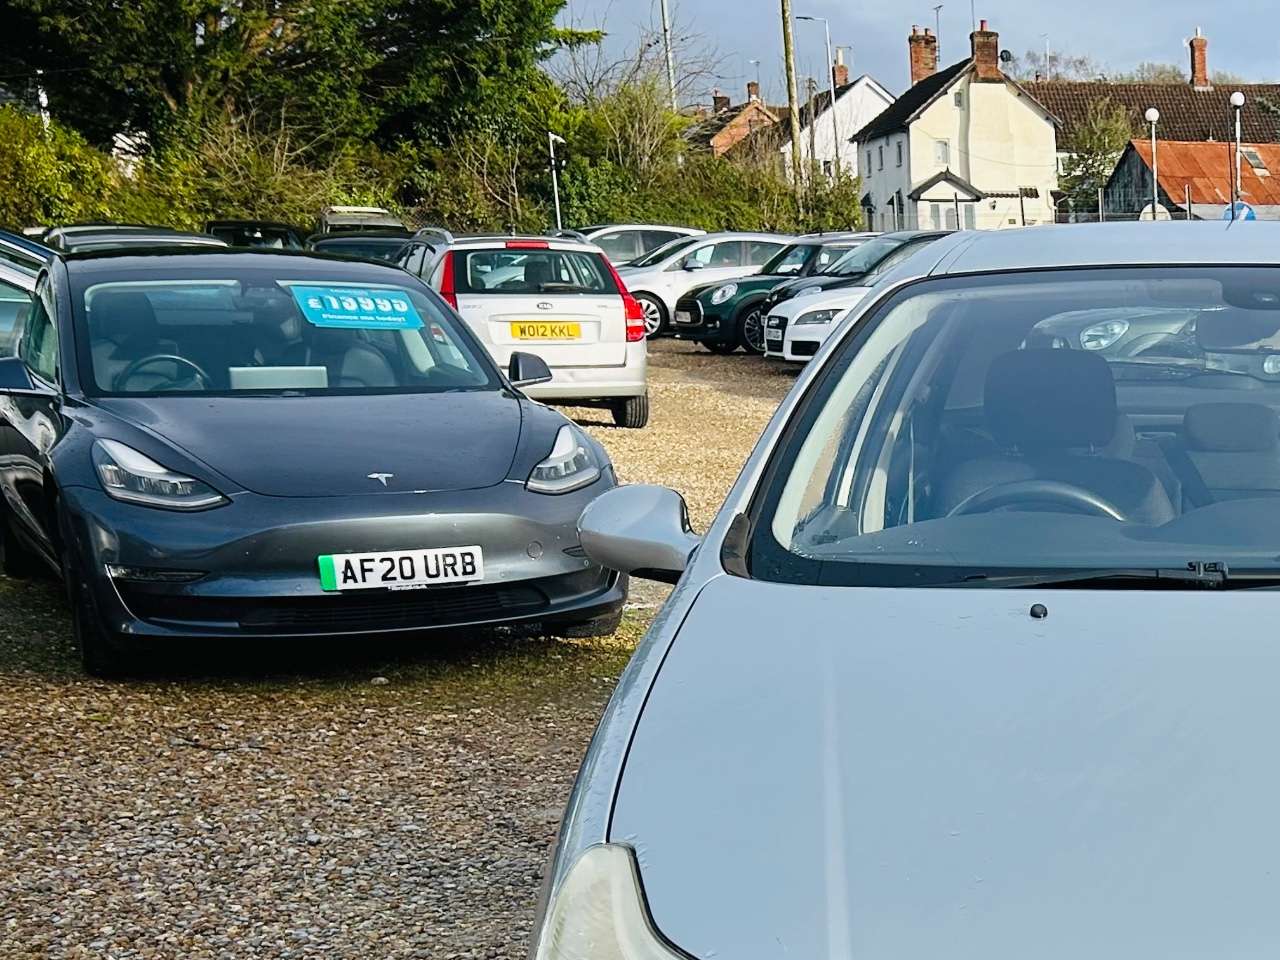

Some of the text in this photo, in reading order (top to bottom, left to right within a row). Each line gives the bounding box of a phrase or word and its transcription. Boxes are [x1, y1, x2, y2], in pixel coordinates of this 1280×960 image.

[551, 325, 575, 337] KKL
[342, 552, 476, 584] AF20 URB
